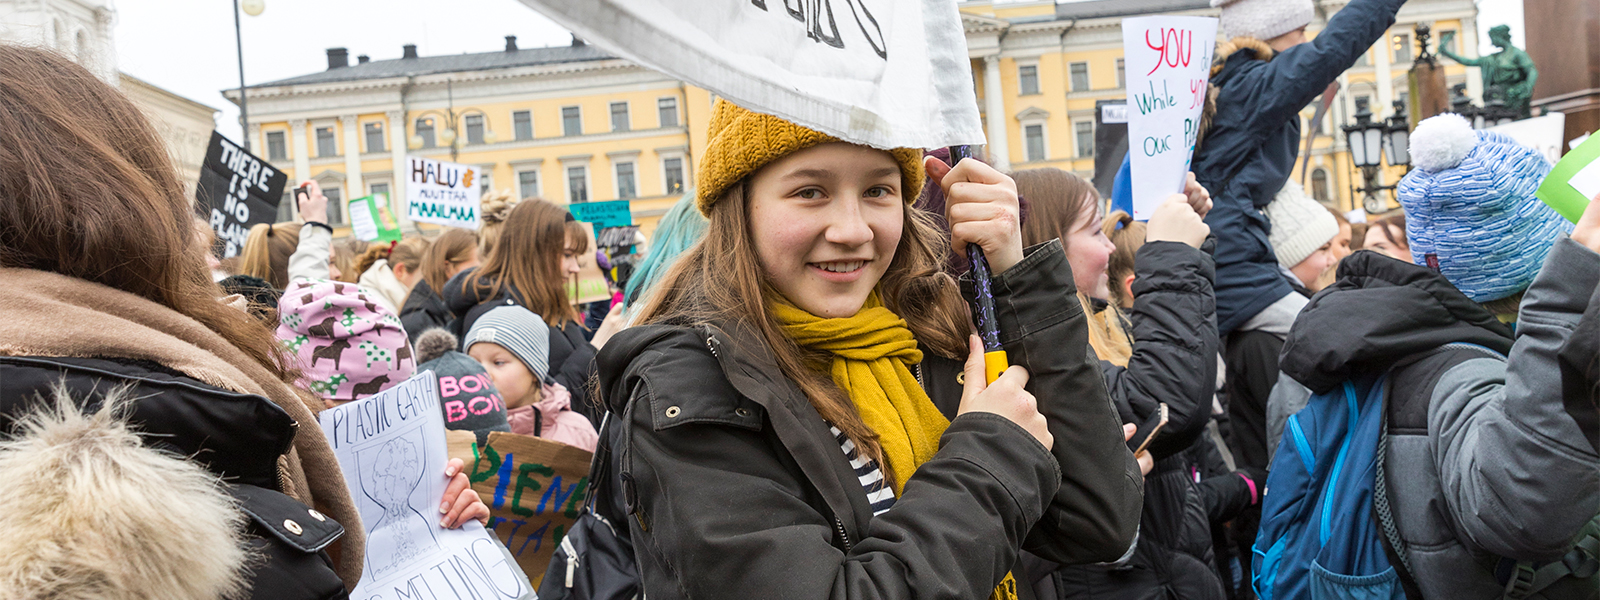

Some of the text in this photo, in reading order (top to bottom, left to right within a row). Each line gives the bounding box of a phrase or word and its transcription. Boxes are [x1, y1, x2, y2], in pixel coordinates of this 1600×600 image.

[1145, 28, 1192, 77] YOU
[220, 139, 274, 193] THERE
[412, 159, 458, 188] HALU
[228, 173, 252, 200] IS
[223, 193, 250, 223] NO
[409, 200, 475, 222] MAAILMAA
[333, 374, 435, 449] PLASTIC EARTH
